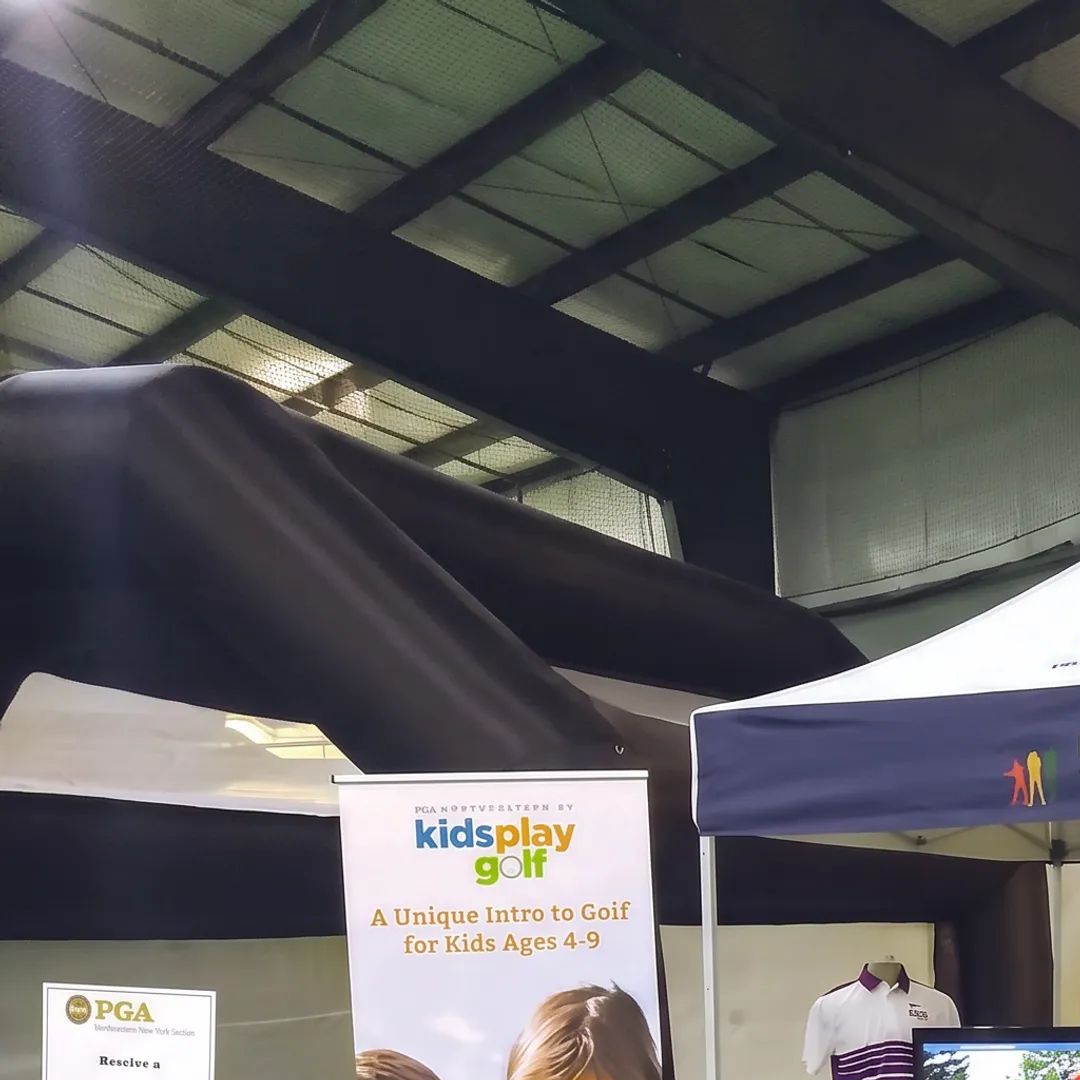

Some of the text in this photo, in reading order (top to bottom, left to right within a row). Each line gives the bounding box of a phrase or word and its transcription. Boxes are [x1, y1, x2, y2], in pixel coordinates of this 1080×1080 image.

[415, 806, 437, 814] PGA
[414, 816, 576, 854] kidsplay
[474, 848, 548, 887] golf
[370, 908, 389, 927] A
[394, 906, 479, 930] Unique
[485, 905, 546, 924] Intro
[551, 904, 574, 922] to
[403, 930, 601, 957] for Kids Ages 4-9
[94, 1000, 155, 1023] PGA
[153, 1061, 161, 1070] a
